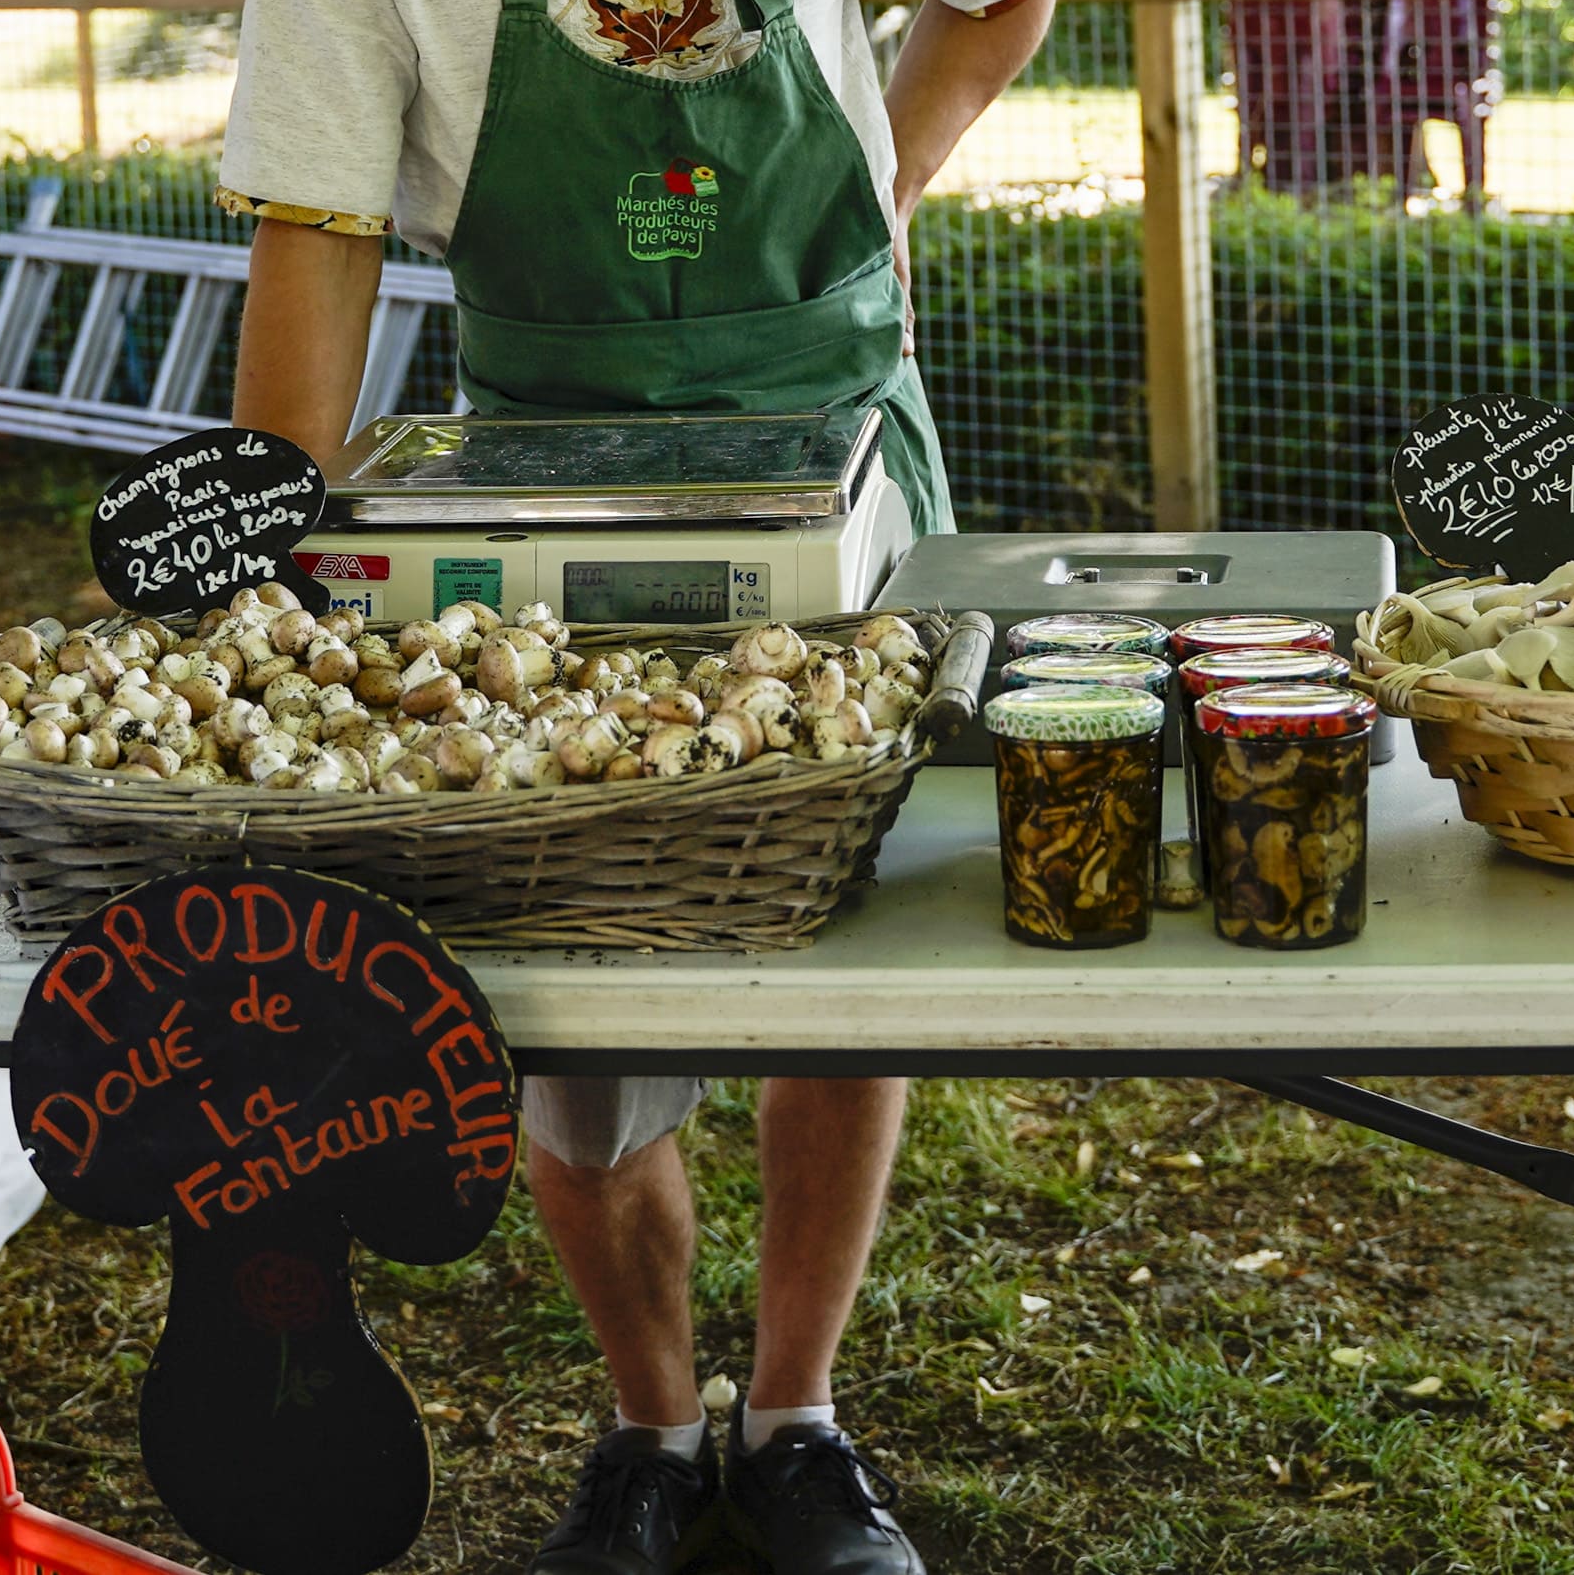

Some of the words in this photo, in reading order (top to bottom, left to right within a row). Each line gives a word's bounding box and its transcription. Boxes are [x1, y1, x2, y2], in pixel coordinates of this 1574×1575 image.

[617, 195, 685, 213] Marchés
[689, 198, 718, 216] des
[617, 212, 717, 231] Producteurs
[637, 230, 658, 244] de
[662, 228, 696, 245] Pays
[236, 433, 269, 457] de
[311, 555, 368, 579] EXA
[734, 568, 757, 587] kg
[231, 975, 300, 1032] de
[41, 883, 516, 1207] PRODUCTEUR
[174, 1087, 435, 1230] Fontaine
